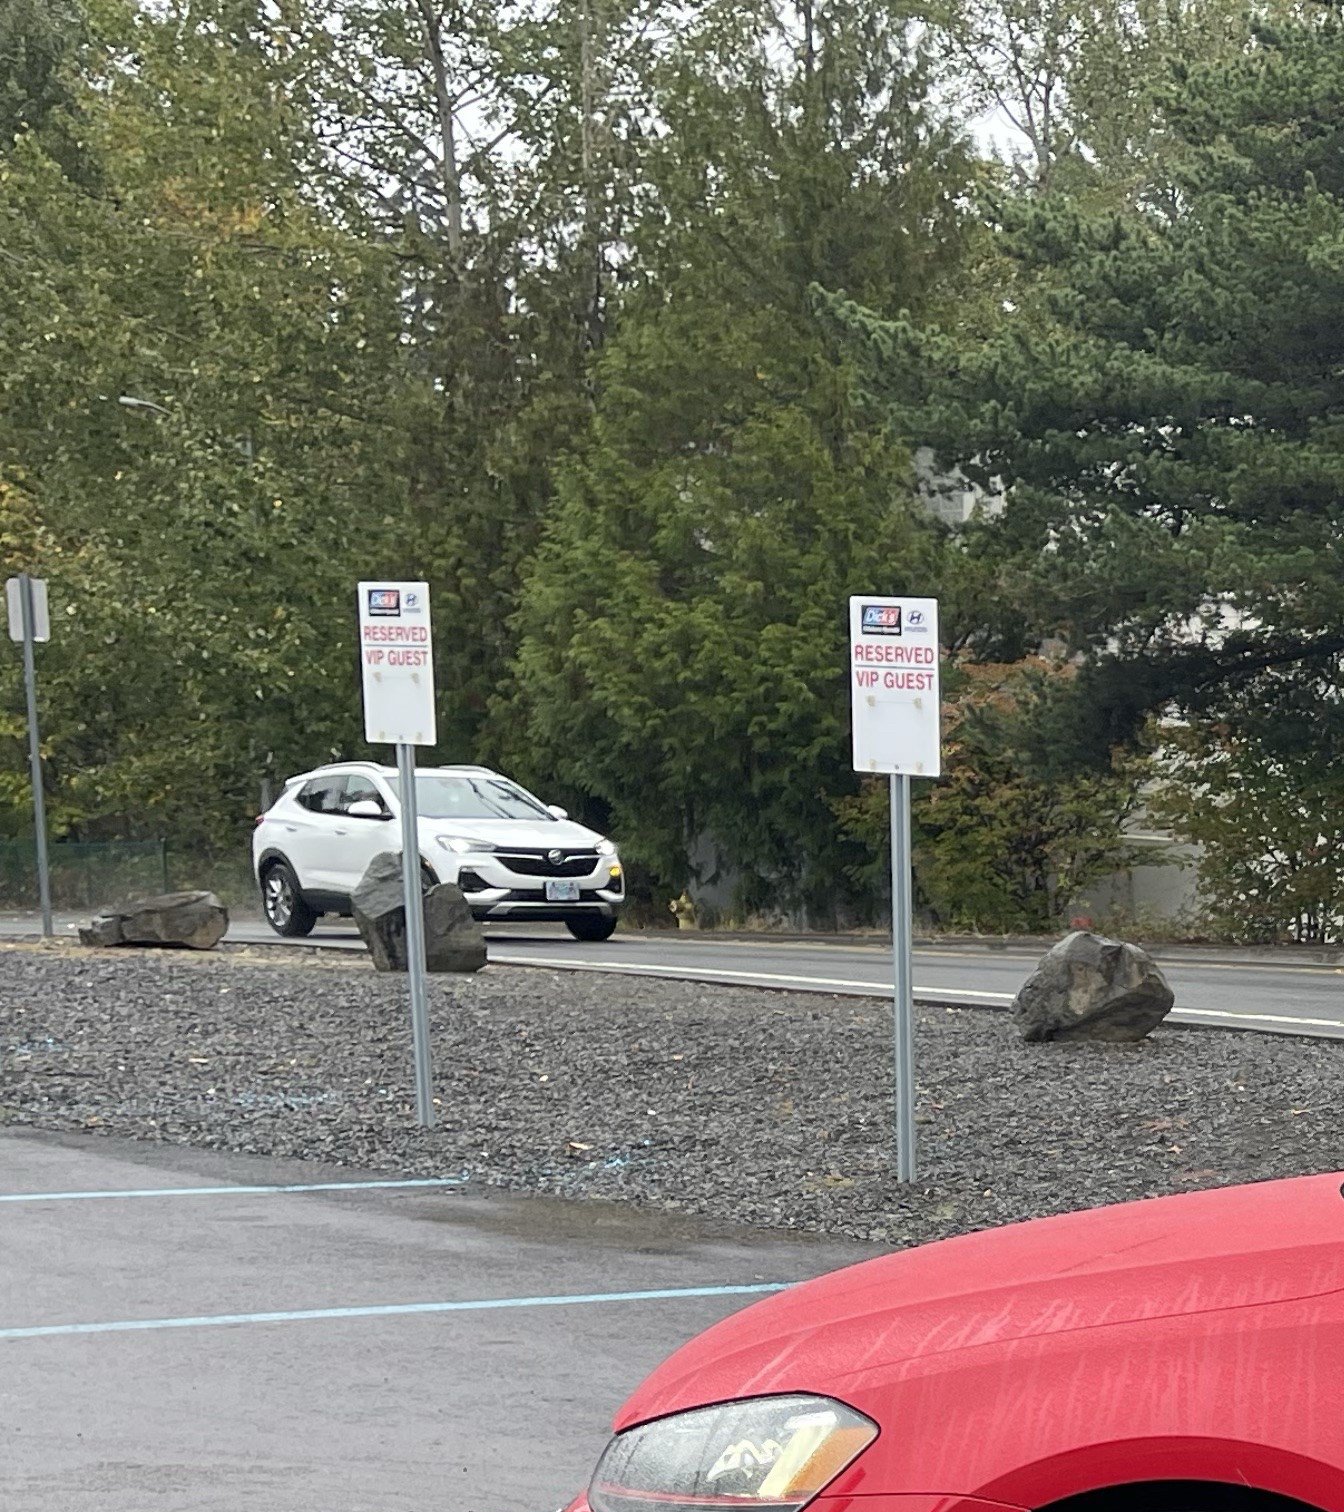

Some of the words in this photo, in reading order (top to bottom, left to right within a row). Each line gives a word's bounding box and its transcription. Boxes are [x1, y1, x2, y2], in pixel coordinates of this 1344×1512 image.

[364, 625, 428, 642] RESERVED
[365, 650, 384, 665] VIP
[388, 650, 429, 666] GUEST
[855, 645, 935, 664] RESERVED
[856, 671, 879, 688] VIP
[884, 672, 935, 691] GUEST
